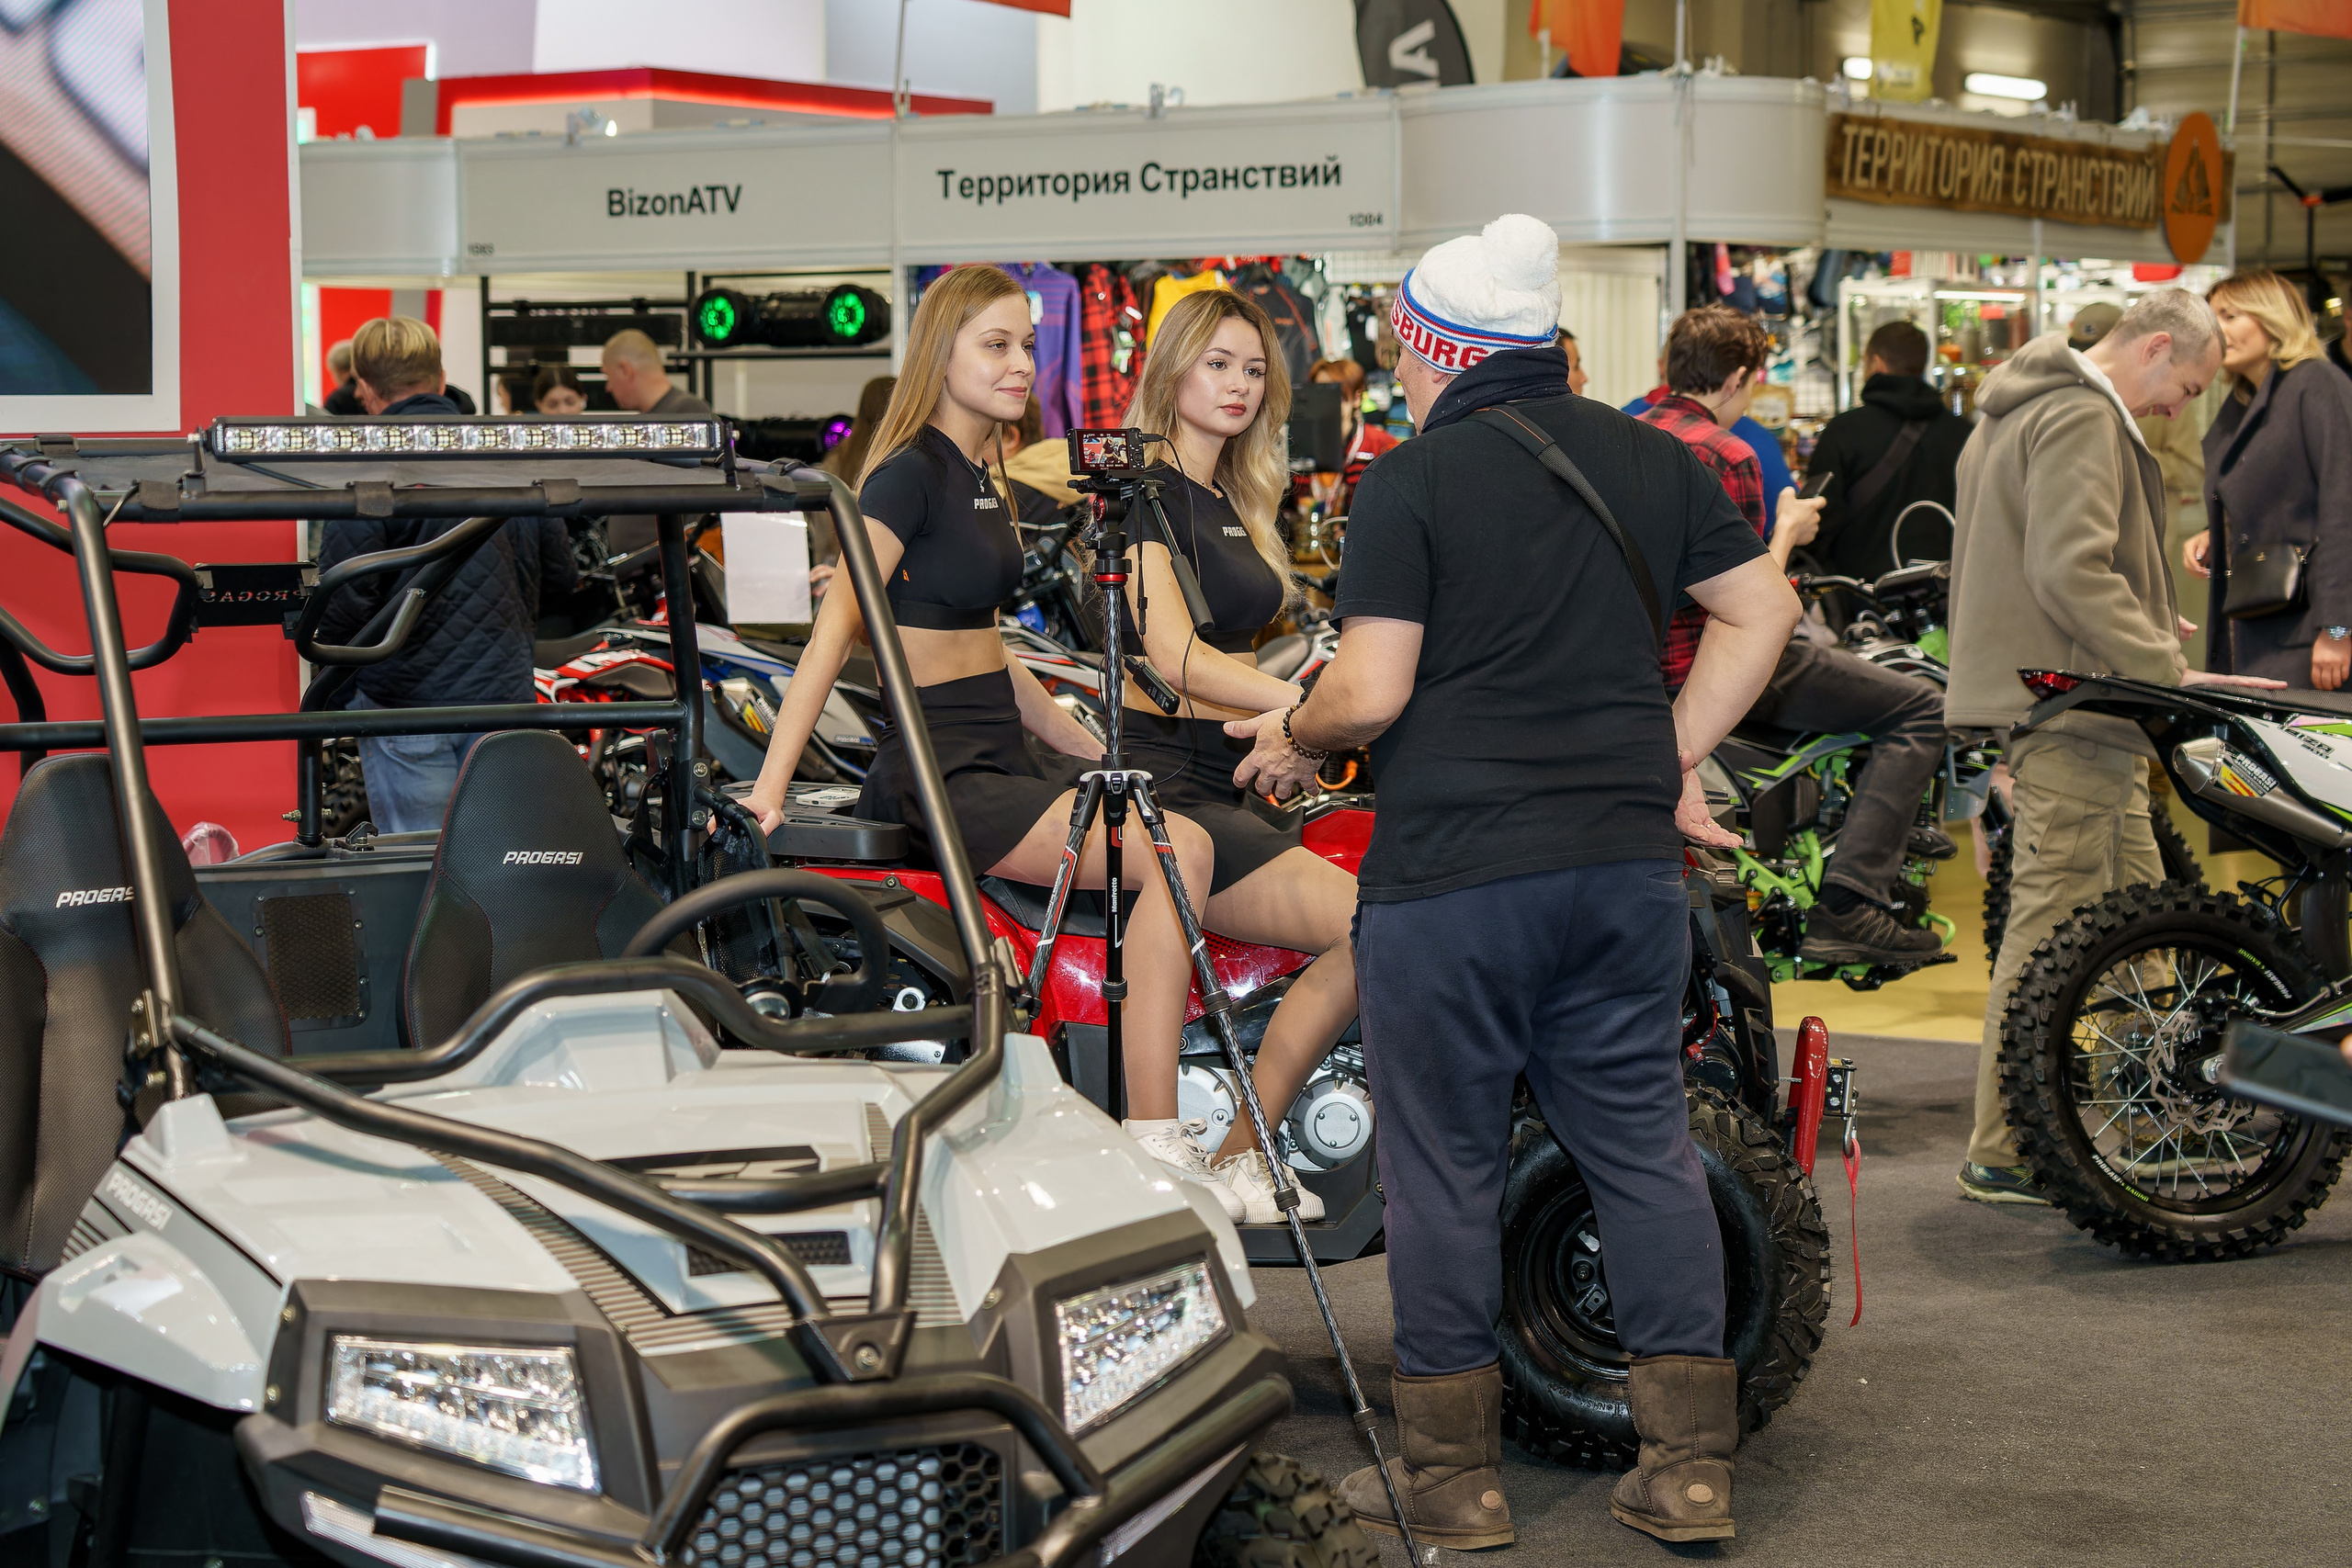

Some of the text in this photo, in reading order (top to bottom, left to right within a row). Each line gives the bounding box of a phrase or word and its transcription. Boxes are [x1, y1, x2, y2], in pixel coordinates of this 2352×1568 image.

[936, 154, 1342, 205] Территория Странствий
[1842, 124, 2156, 220] ТЕРРИТОРИЯ СТРАНСТВИЙ
[607, 184, 742, 217] BizonATV
[503, 851, 583, 865] PROGASI
[55, 886, 134, 908] PROGAS
[107, 1170, 174, 1231] PROGASI
